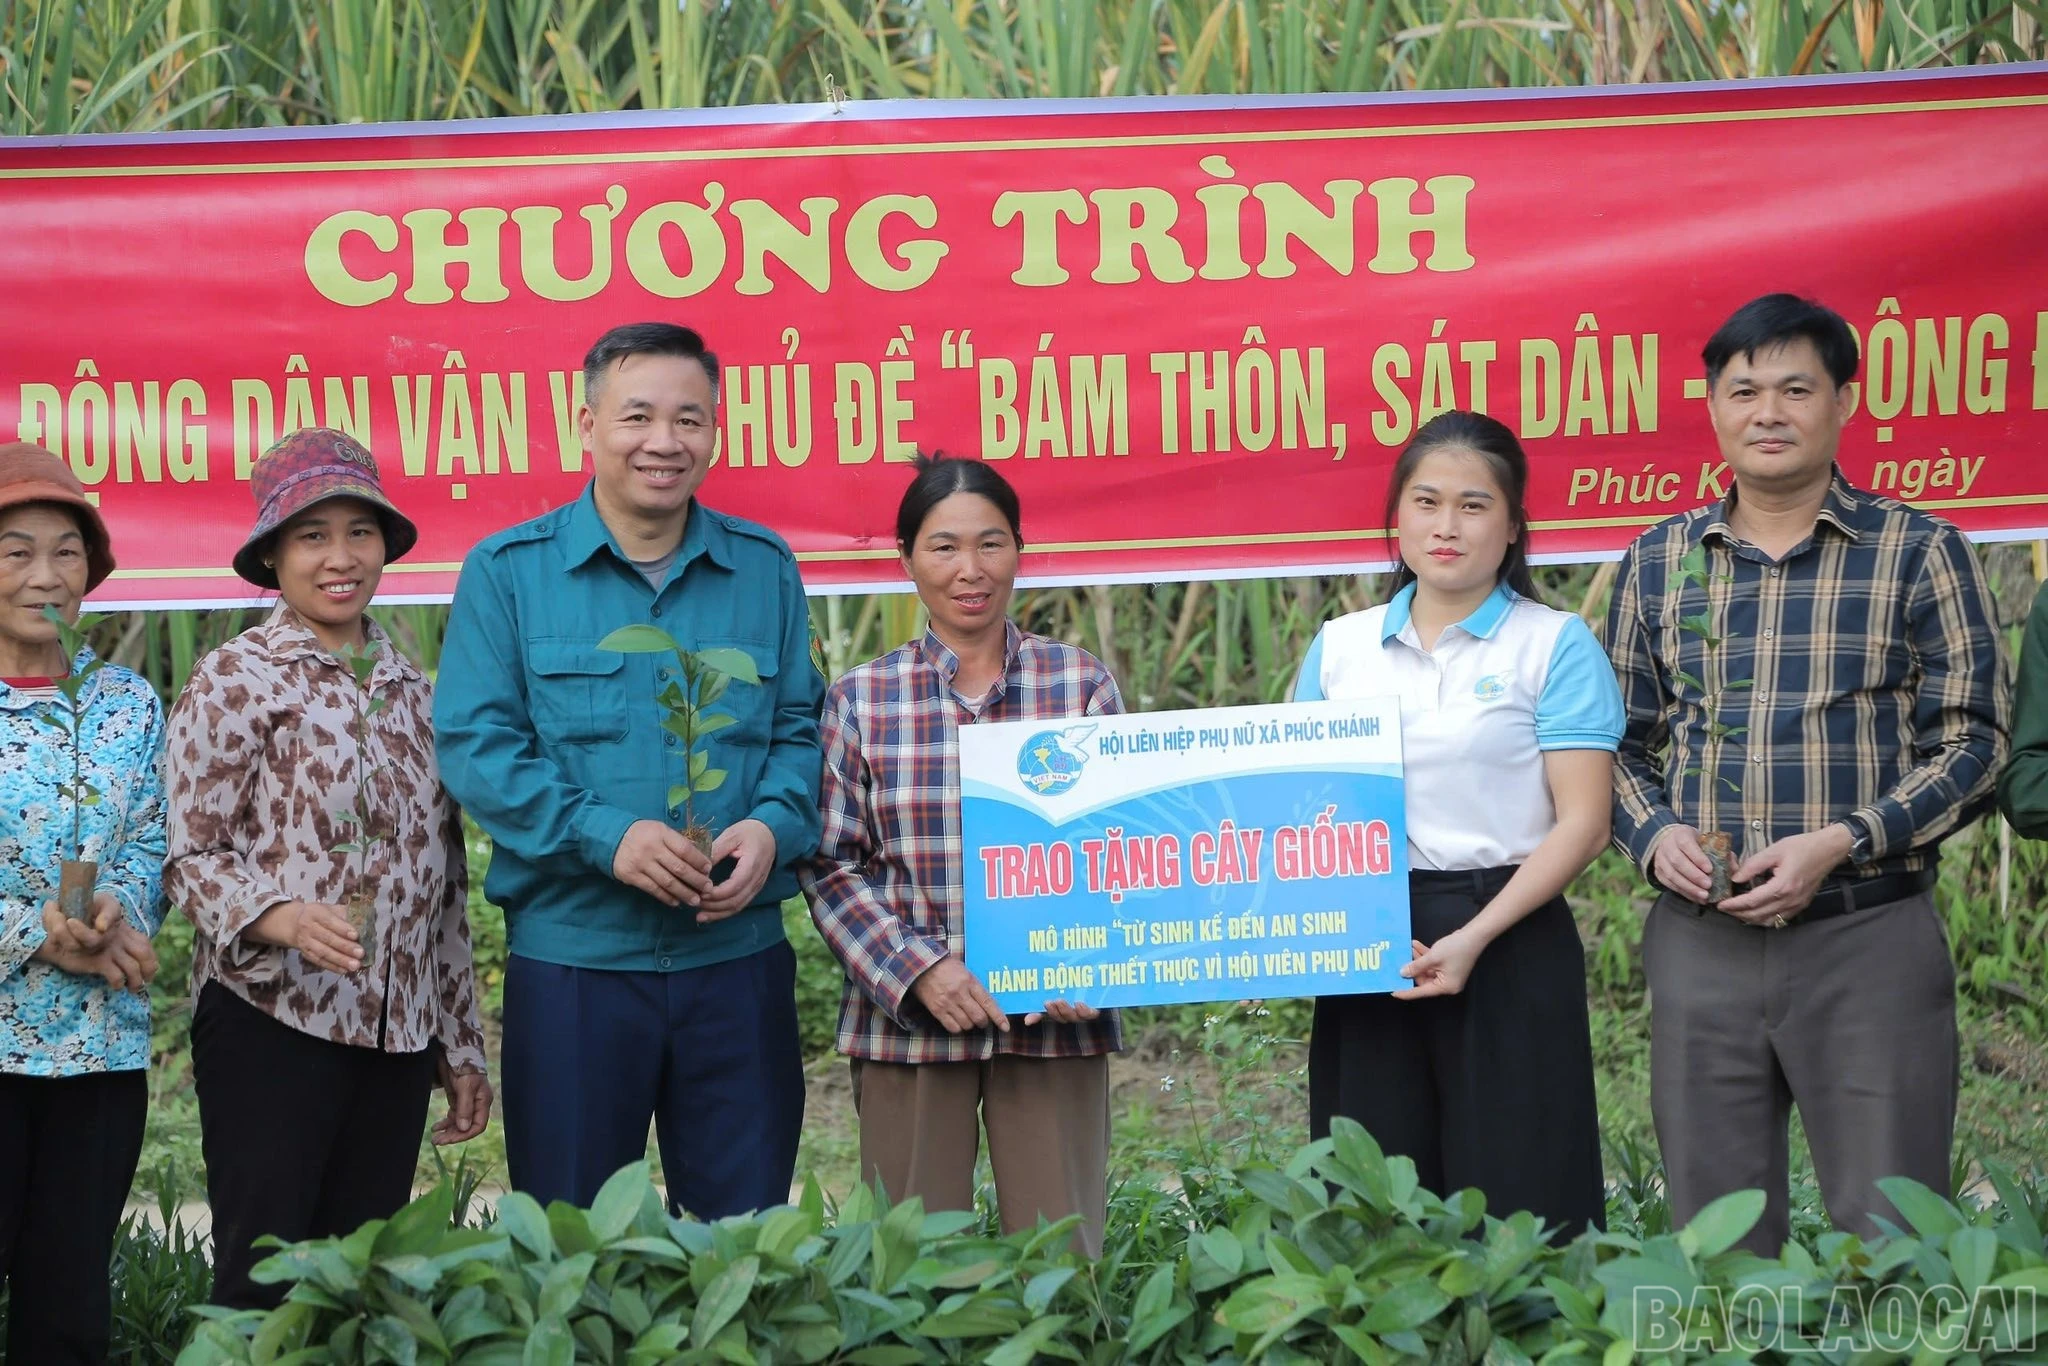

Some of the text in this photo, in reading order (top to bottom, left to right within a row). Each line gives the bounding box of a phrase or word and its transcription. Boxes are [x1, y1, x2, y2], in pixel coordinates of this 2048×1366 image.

[304, 155, 1476, 306] CHƯƠNG TRÌNH
[18, 359, 208, 508] ĐỘNG
[232, 354, 371, 480] DÂN
[393, 351, 528, 499] VẬN
[709, 327, 812, 468] HỦ
[834, 325, 918, 464] ĐỀ
[942, 329, 1130, 460] “BÁM
[1150, 326, 1347, 461] THÔN,
[1371, 319, 1497, 446] SÁT
[1520, 313, 1658, 438] DÂN
[1567, 464, 1681, 506] Phúc
[1871, 448, 1986, 499] ngày
[1099, 713, 1381, 761] HỘI LIÊN HIỆP PHỤ NỮ XÃ PHÚC KHÁNH
[979, 804, 1392, 903] TRAO TẶNG CÂY GIỐNG
[1029, 925, 1058, 953] MÔ
[1063, 923, 1108, 951] HÌNH
[1150, 919, 1194, 945] SINH
[1199, 912, 1223, 942] KẾ
[1228, 911, 1265, 940] ĐẾN
[1271, 914, 1296, 938] AN
[1302, 911, 1347, 936] SINH
[988, 966, 1038, 994] HÀNH
[1043, 963, 1094, 994] ĐỘNG
[1099, 956, 1147, 986] THIẾT
[1154, 957, 1200, 986] THỰC
[1204, 952, 1222, 980] VÌ
[1228, 951, 1258, 982] HỘI
[1263, 947, 1306, 976] VIÊN
[1311, 949, 1349, 978] PHỤ
